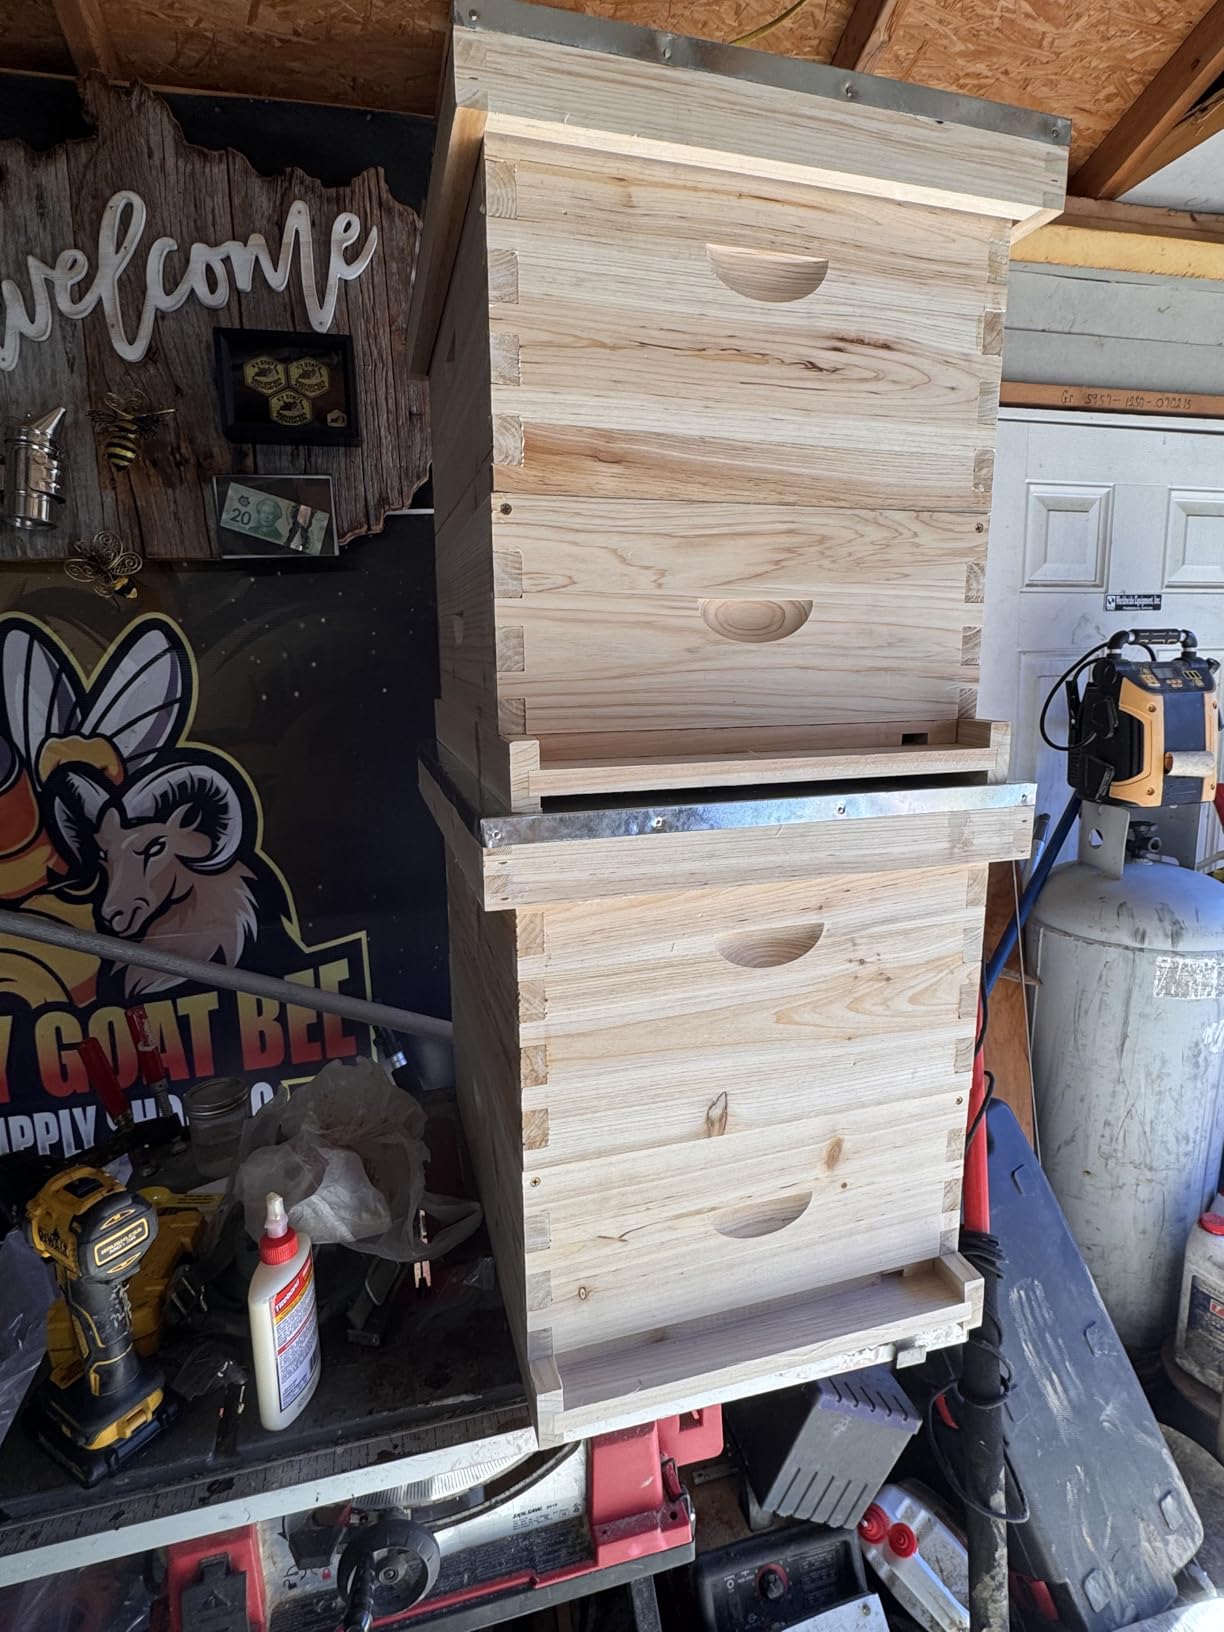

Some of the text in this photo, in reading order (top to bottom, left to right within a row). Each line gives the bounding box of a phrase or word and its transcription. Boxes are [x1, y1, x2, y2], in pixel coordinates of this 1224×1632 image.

[230, 508, 251, 525] 20
[34, 991, 219, 1099] GOAT
[237, 958, 358, 1072] BEE
